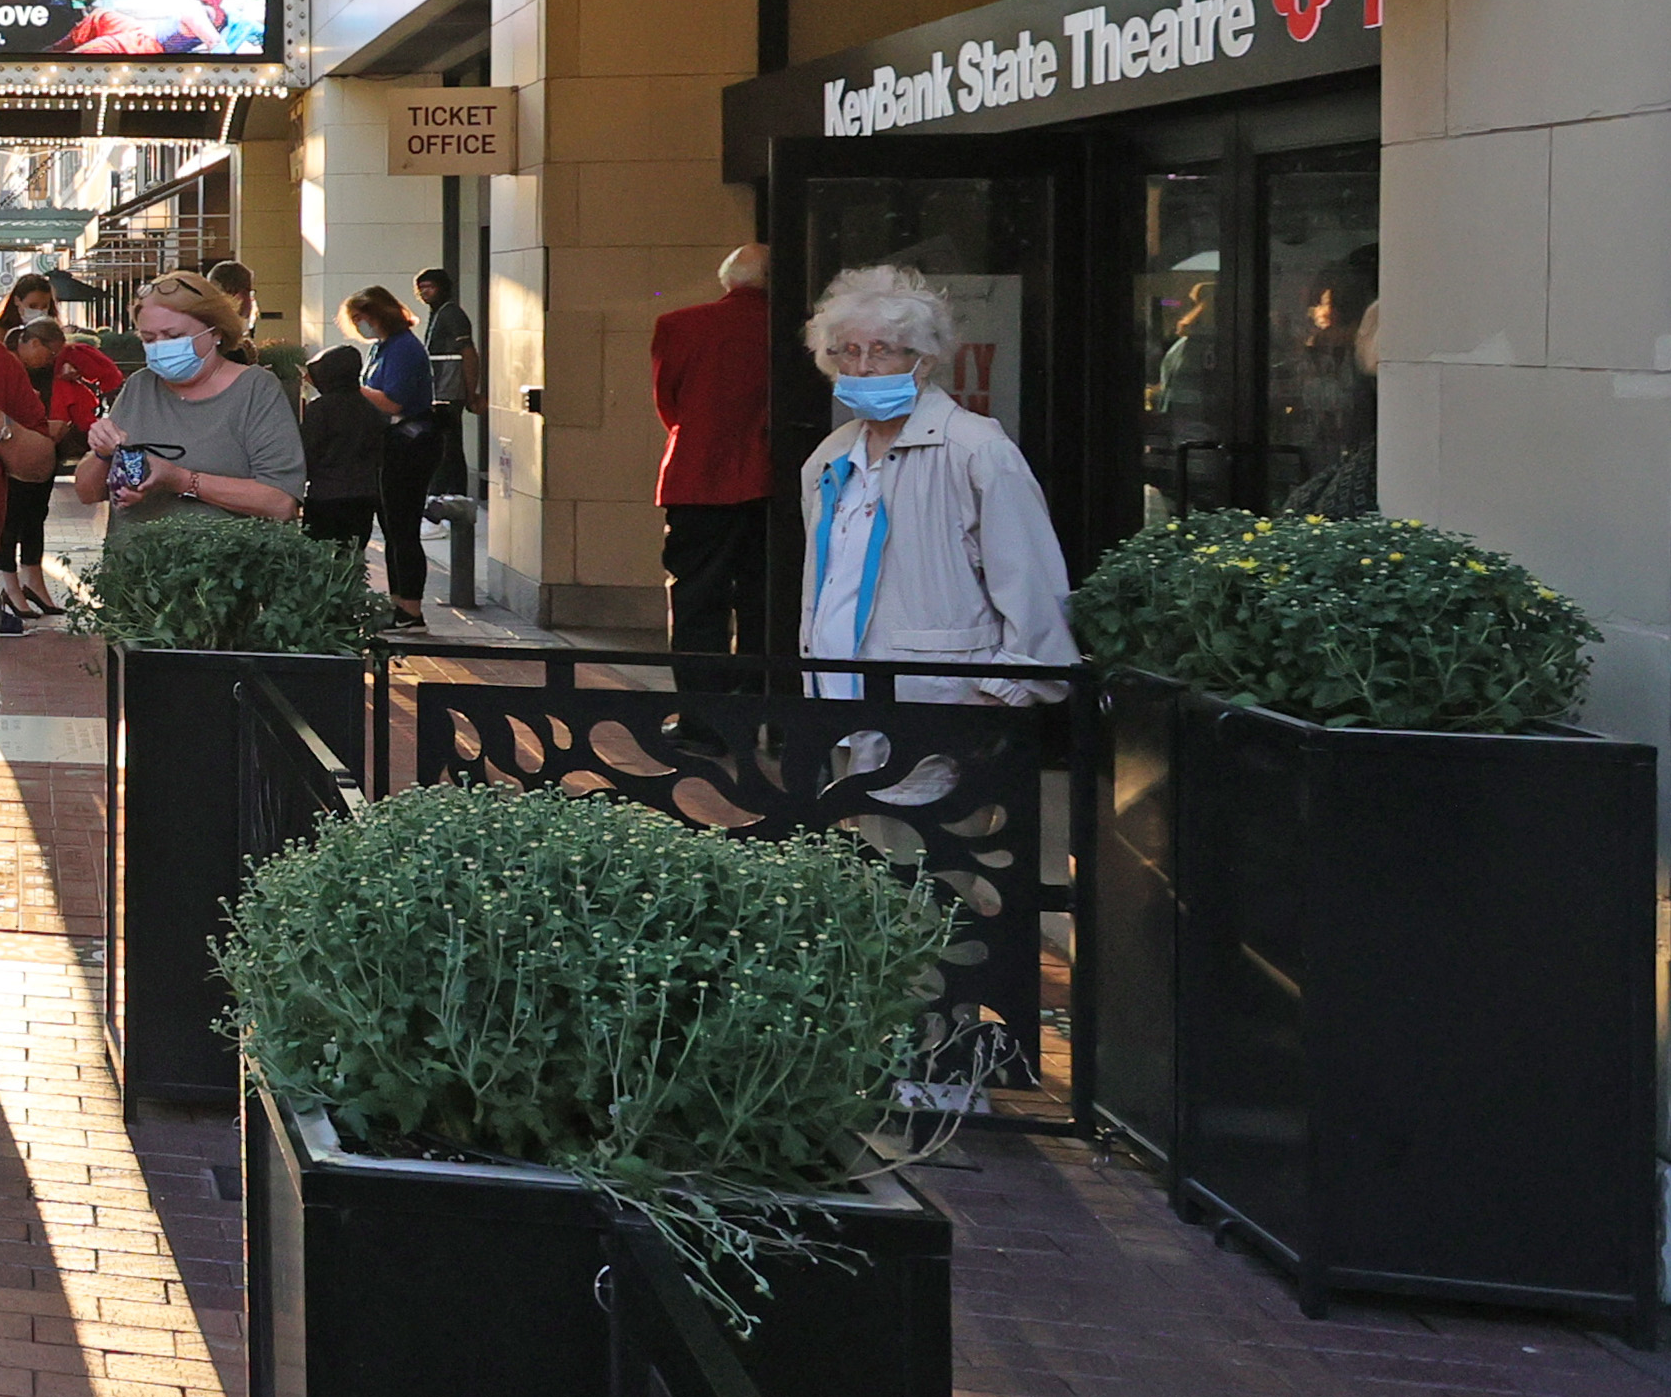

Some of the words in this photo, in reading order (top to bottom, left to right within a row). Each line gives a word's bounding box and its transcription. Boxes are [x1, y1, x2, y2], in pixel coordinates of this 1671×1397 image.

[823, 52, 955, 137] KeyBank
[957, 30, 1058, 114] State
[407, 106, 497, 126] TICKET
[407, 134, 496, 154] OFFICE
